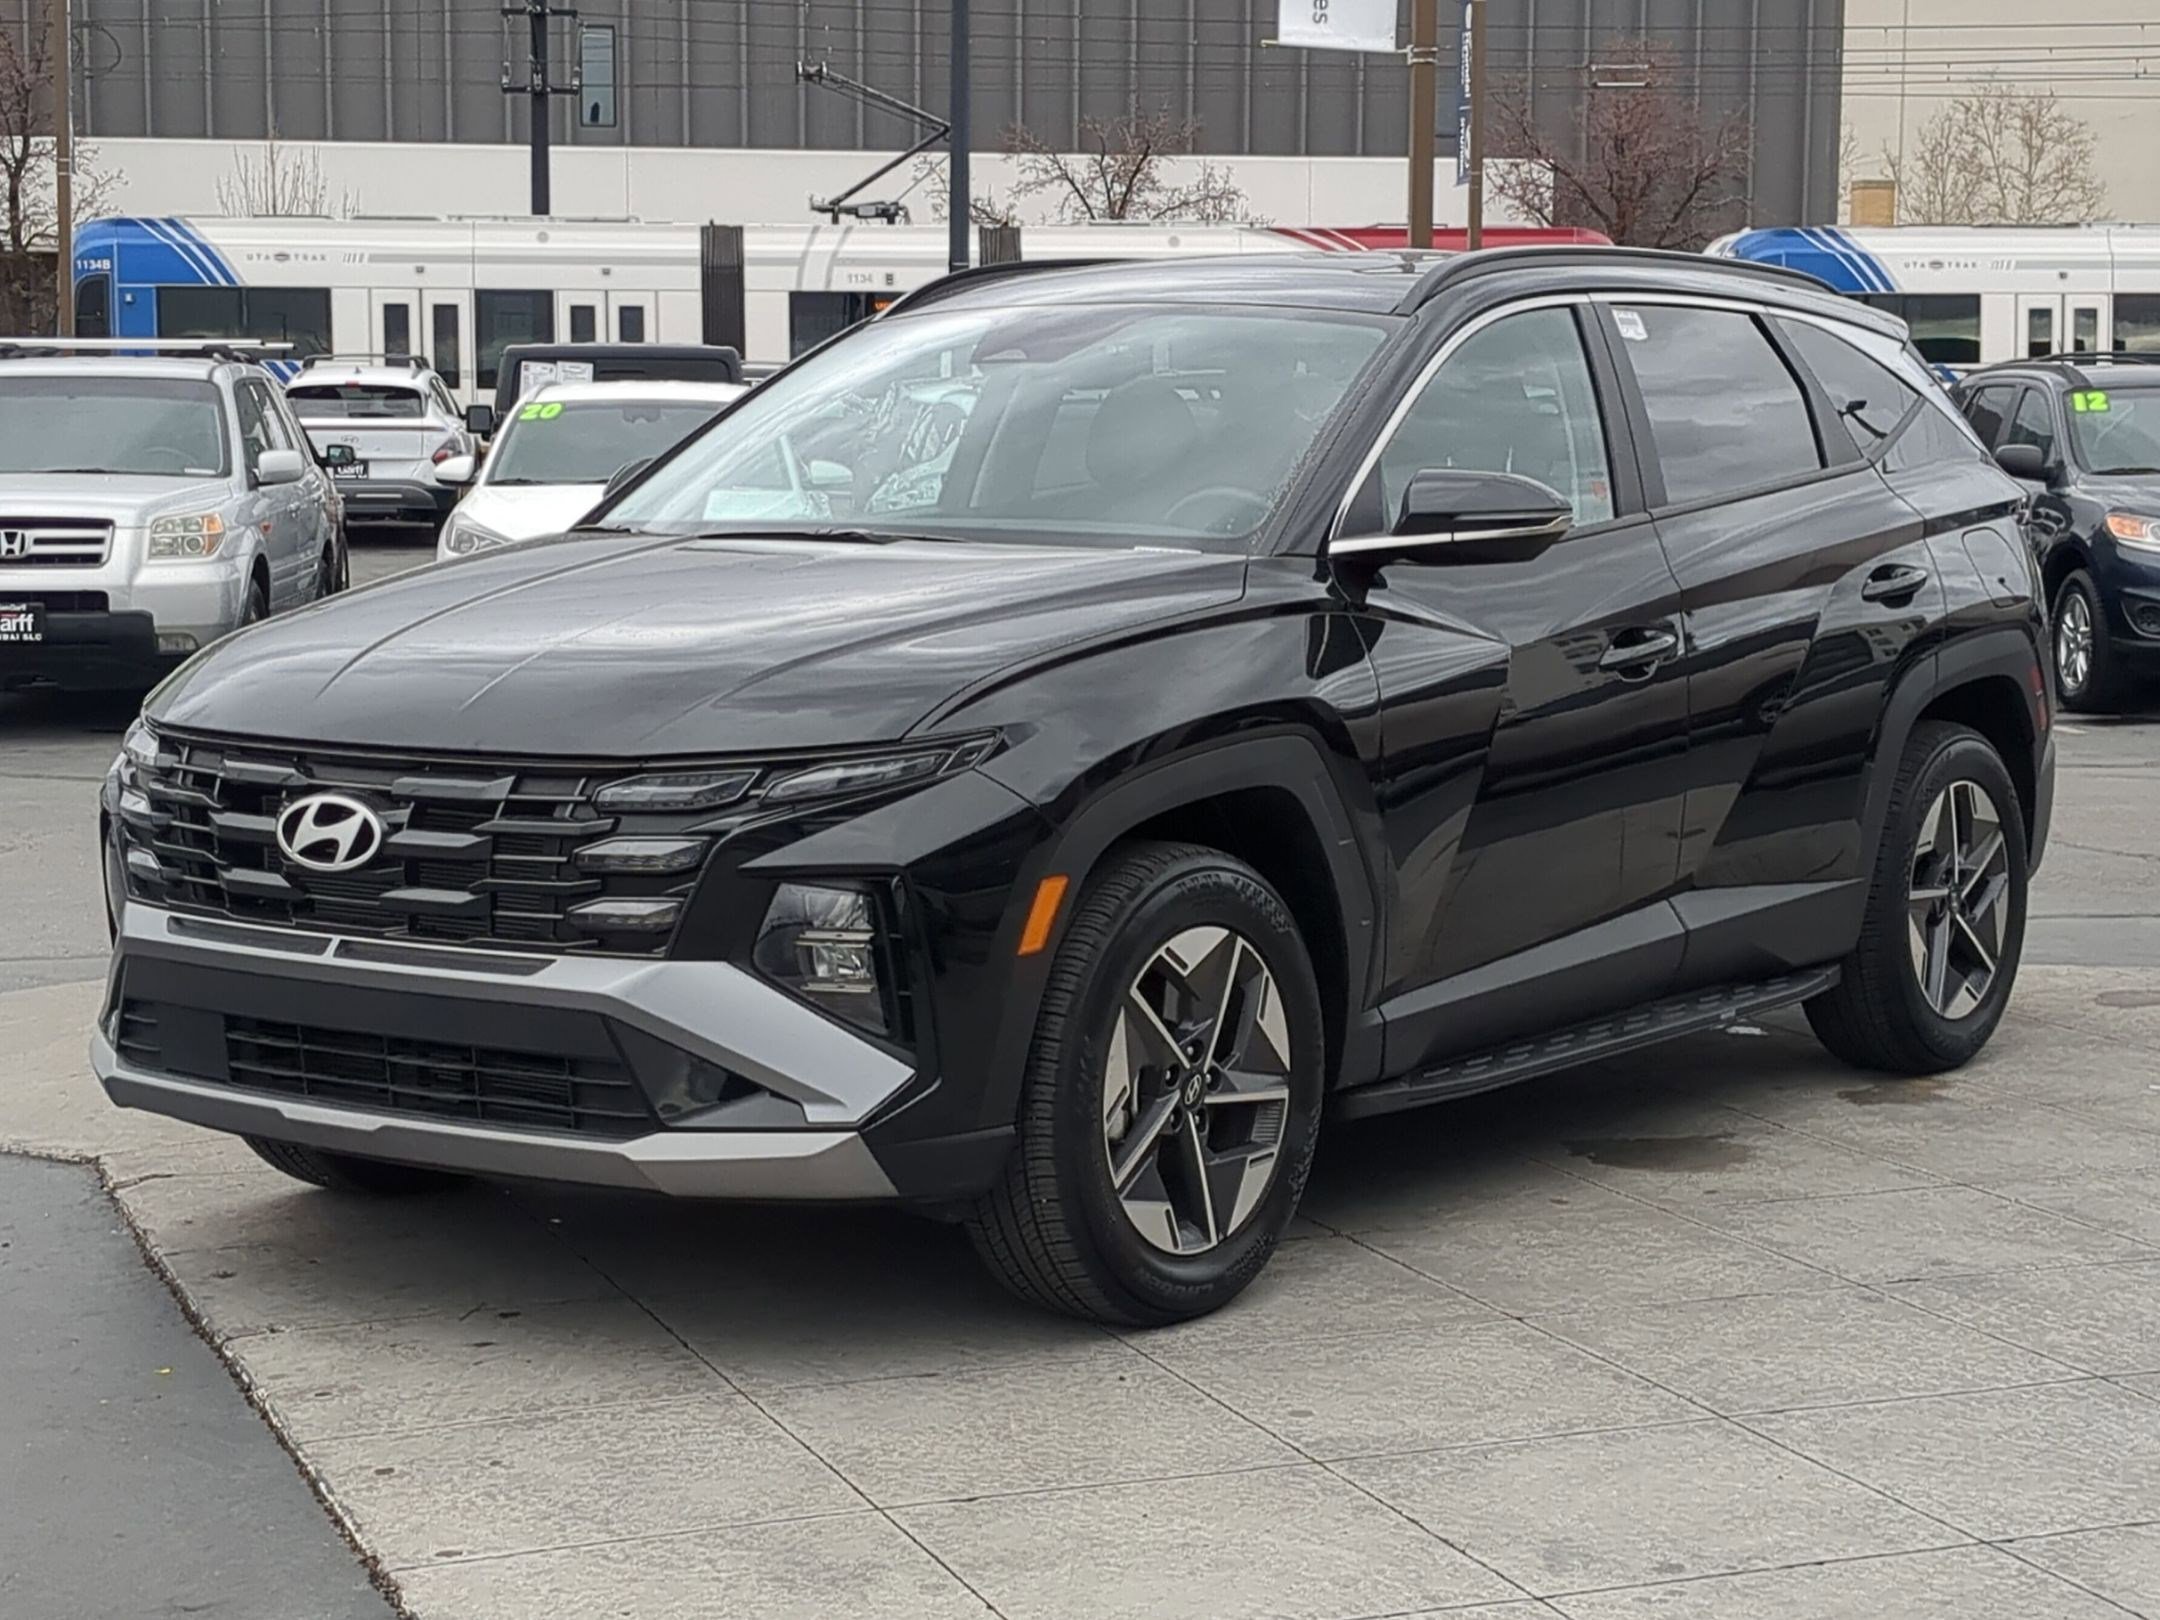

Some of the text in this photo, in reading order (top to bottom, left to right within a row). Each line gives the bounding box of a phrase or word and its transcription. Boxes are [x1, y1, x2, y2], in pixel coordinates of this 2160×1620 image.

[1312, 0, 1328, 25] es
[246, 252, 326, 261] UTA TRAX
[76, 258, 112, 271] 1134B
[1903, 260, 1926, 269] UTA
[2072, 391, 2109, 412] 12
[519, 402, 563, 420] 20
